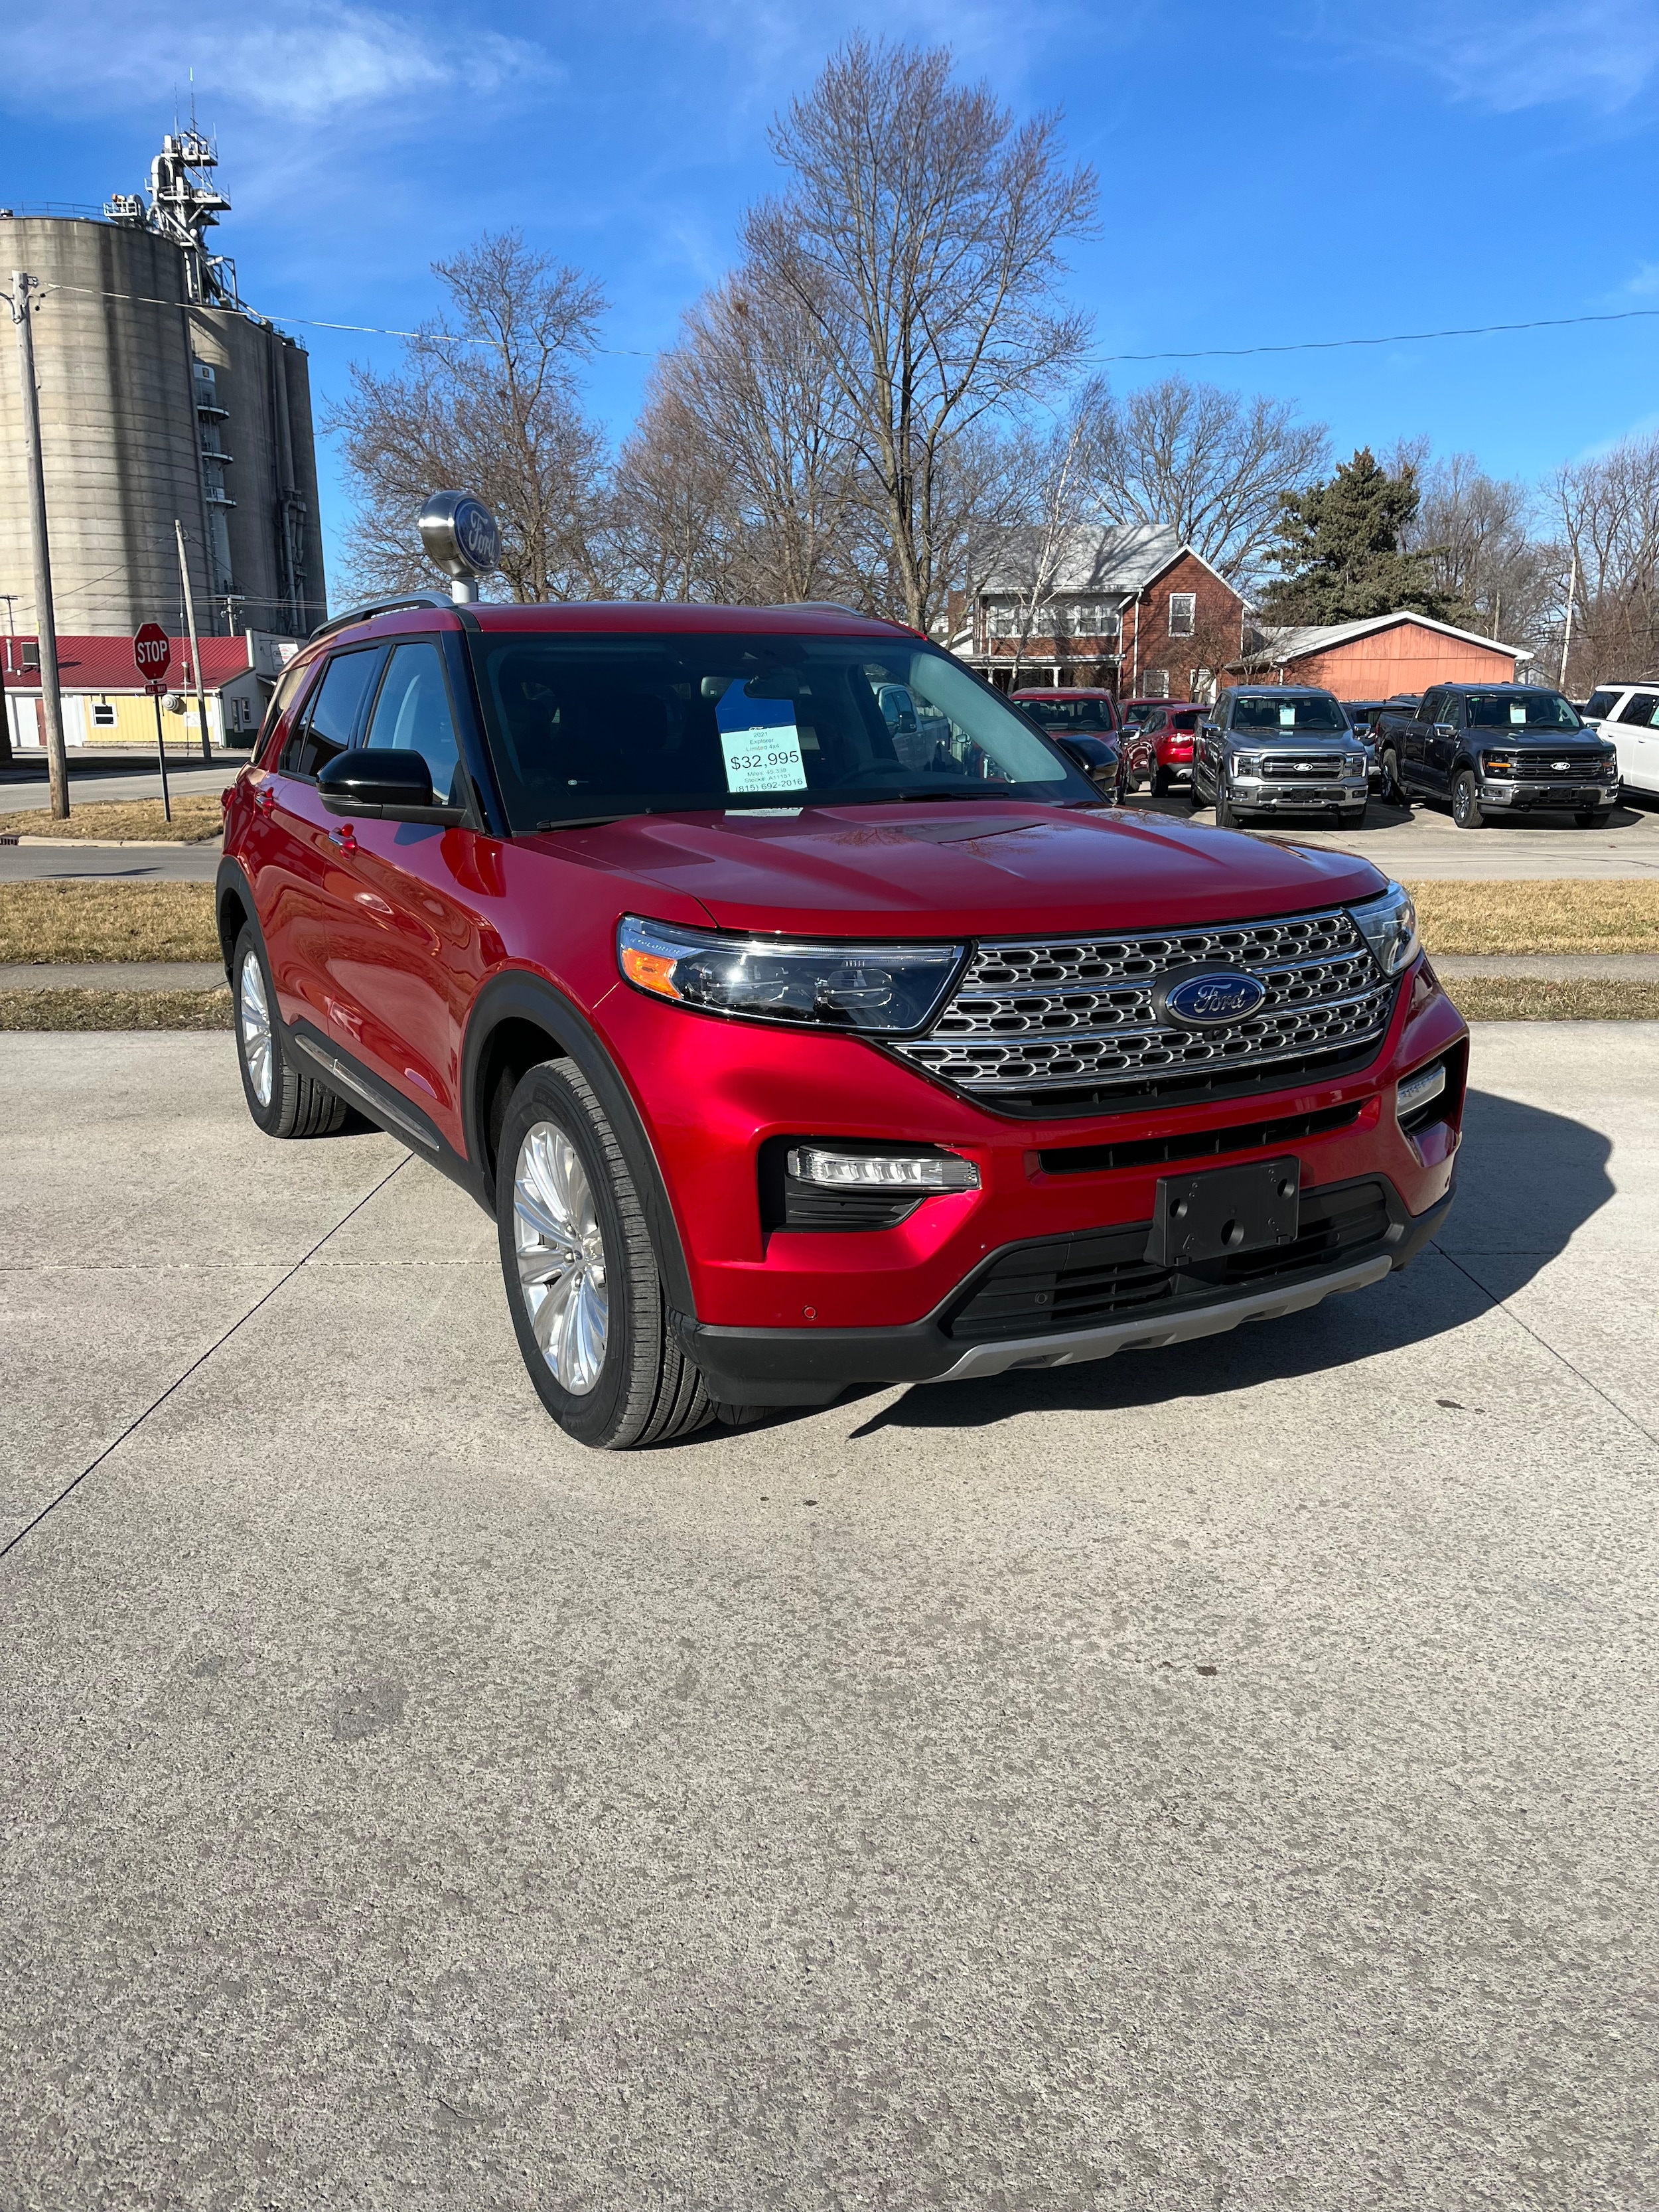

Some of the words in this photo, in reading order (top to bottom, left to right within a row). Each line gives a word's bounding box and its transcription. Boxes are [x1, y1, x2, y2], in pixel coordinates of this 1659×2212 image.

[469, 510, 495, 559] Ford
[137, 640, 167, 663] STOP
[731, 751, 799, 771] $32,995
[761, 778, 803, 790] 692-2016
[1193, 984, 1246, 1013] Ford
